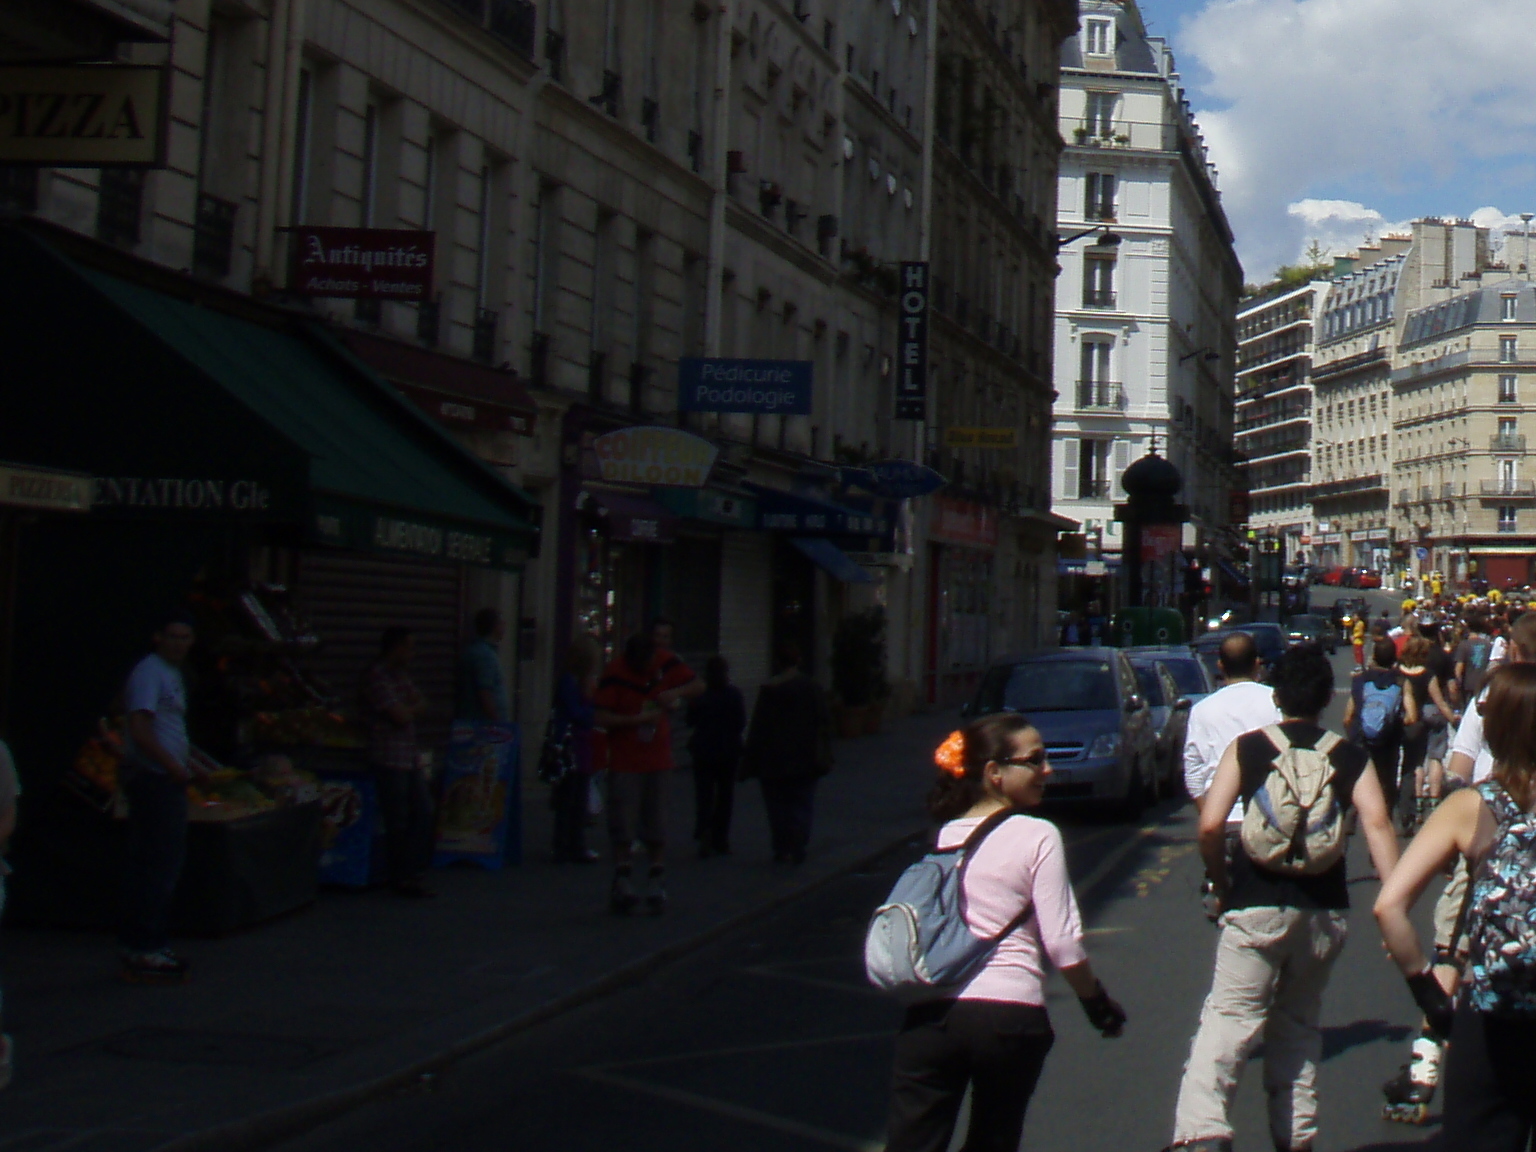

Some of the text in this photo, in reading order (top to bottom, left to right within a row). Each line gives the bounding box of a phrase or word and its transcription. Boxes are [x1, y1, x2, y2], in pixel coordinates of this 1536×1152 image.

[304, 235, 427, 272] Antiquités
[306, 277, 359, 292] Achats
[372, 279, 423, 295] Ventes
[902, 265, 926, 391] HOTEL
[696, 385, 796, 410] Podologie
[596, 429, 712, 467] COIFFEUR
